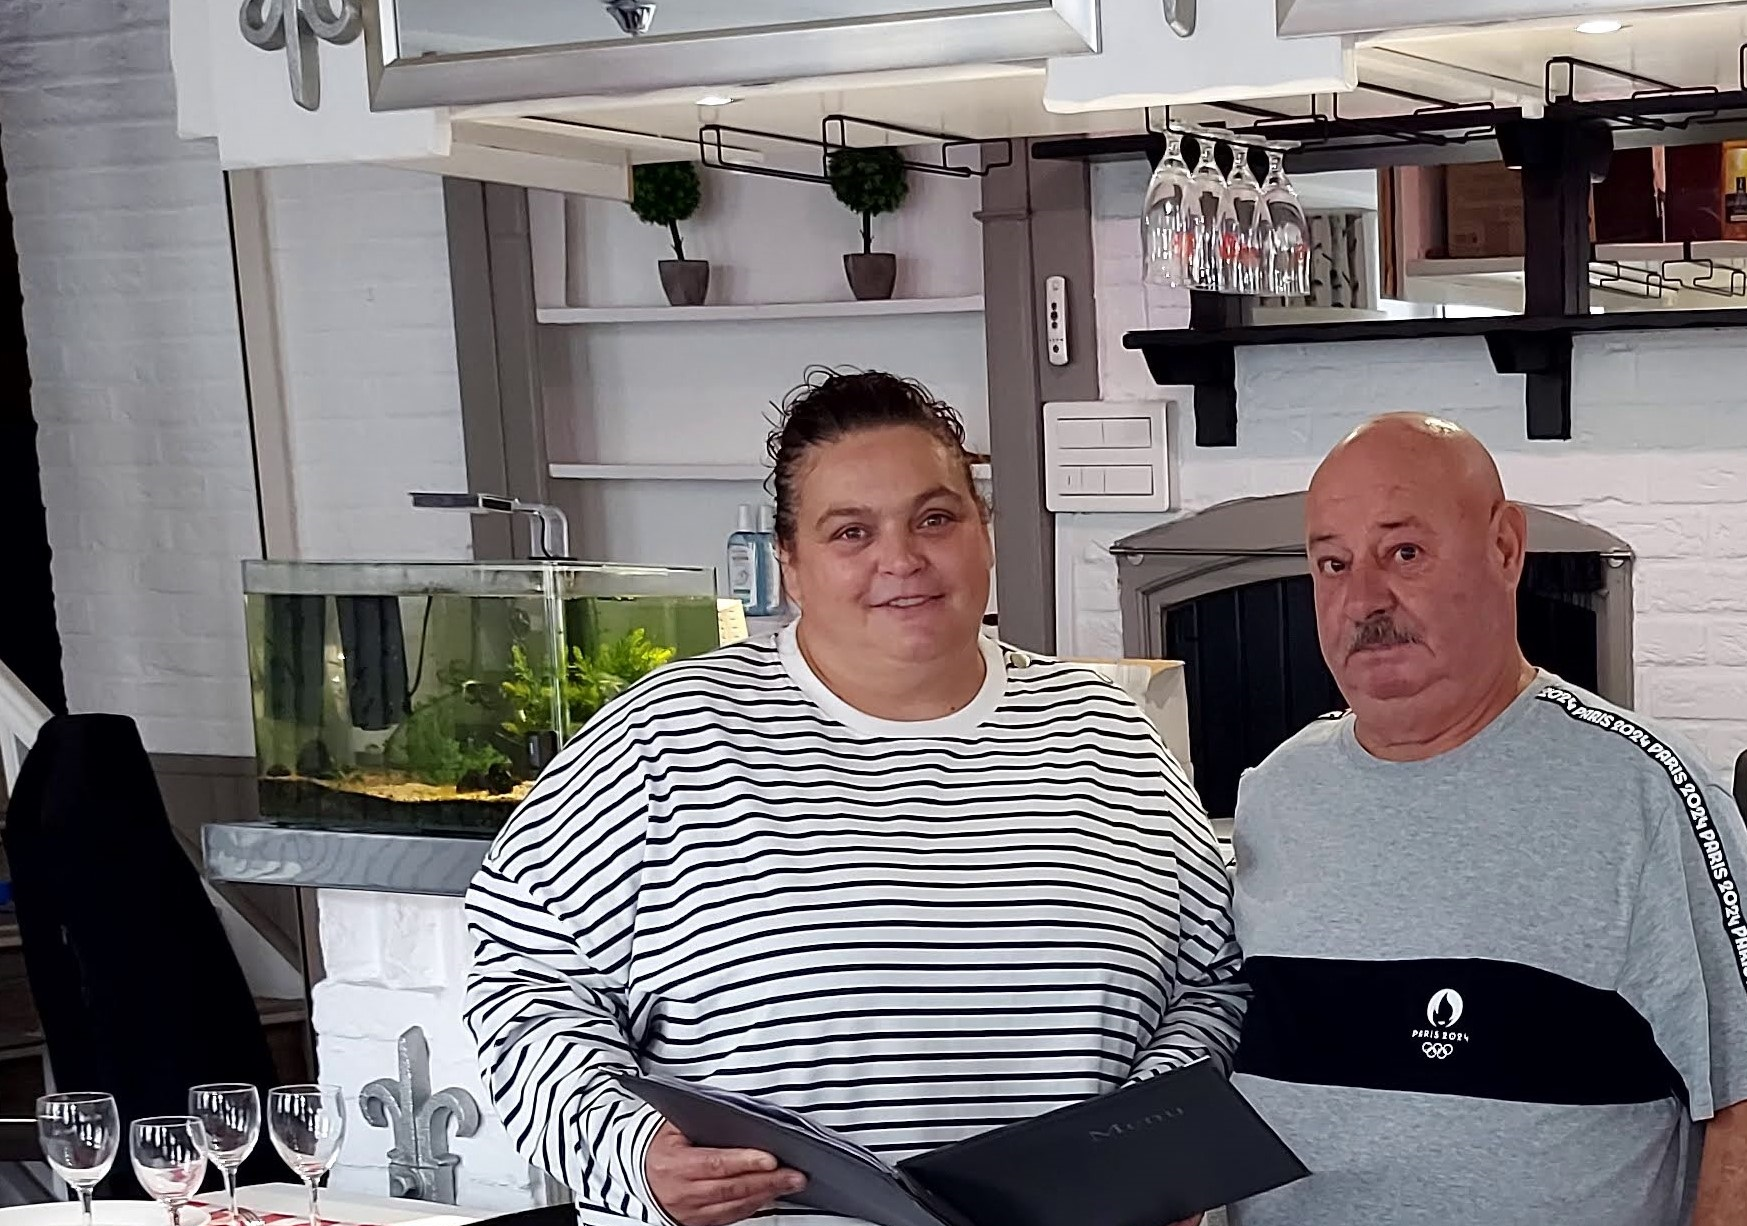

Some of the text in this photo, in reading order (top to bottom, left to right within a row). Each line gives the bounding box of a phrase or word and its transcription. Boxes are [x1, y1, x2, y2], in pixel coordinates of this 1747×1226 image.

[1572, 707, 1615, 728] PARIS
[1610, 719, 1650, 748] 2024
[1647, 742, 1688, 785] PARIS
[1679, 783, 1708, 830] 2024
[1699, 829, 1729, 880] PARIS
[1717, 880, 1741, 927] 2024
[1411, 1029, 1469, 1043] PARIS 2024
